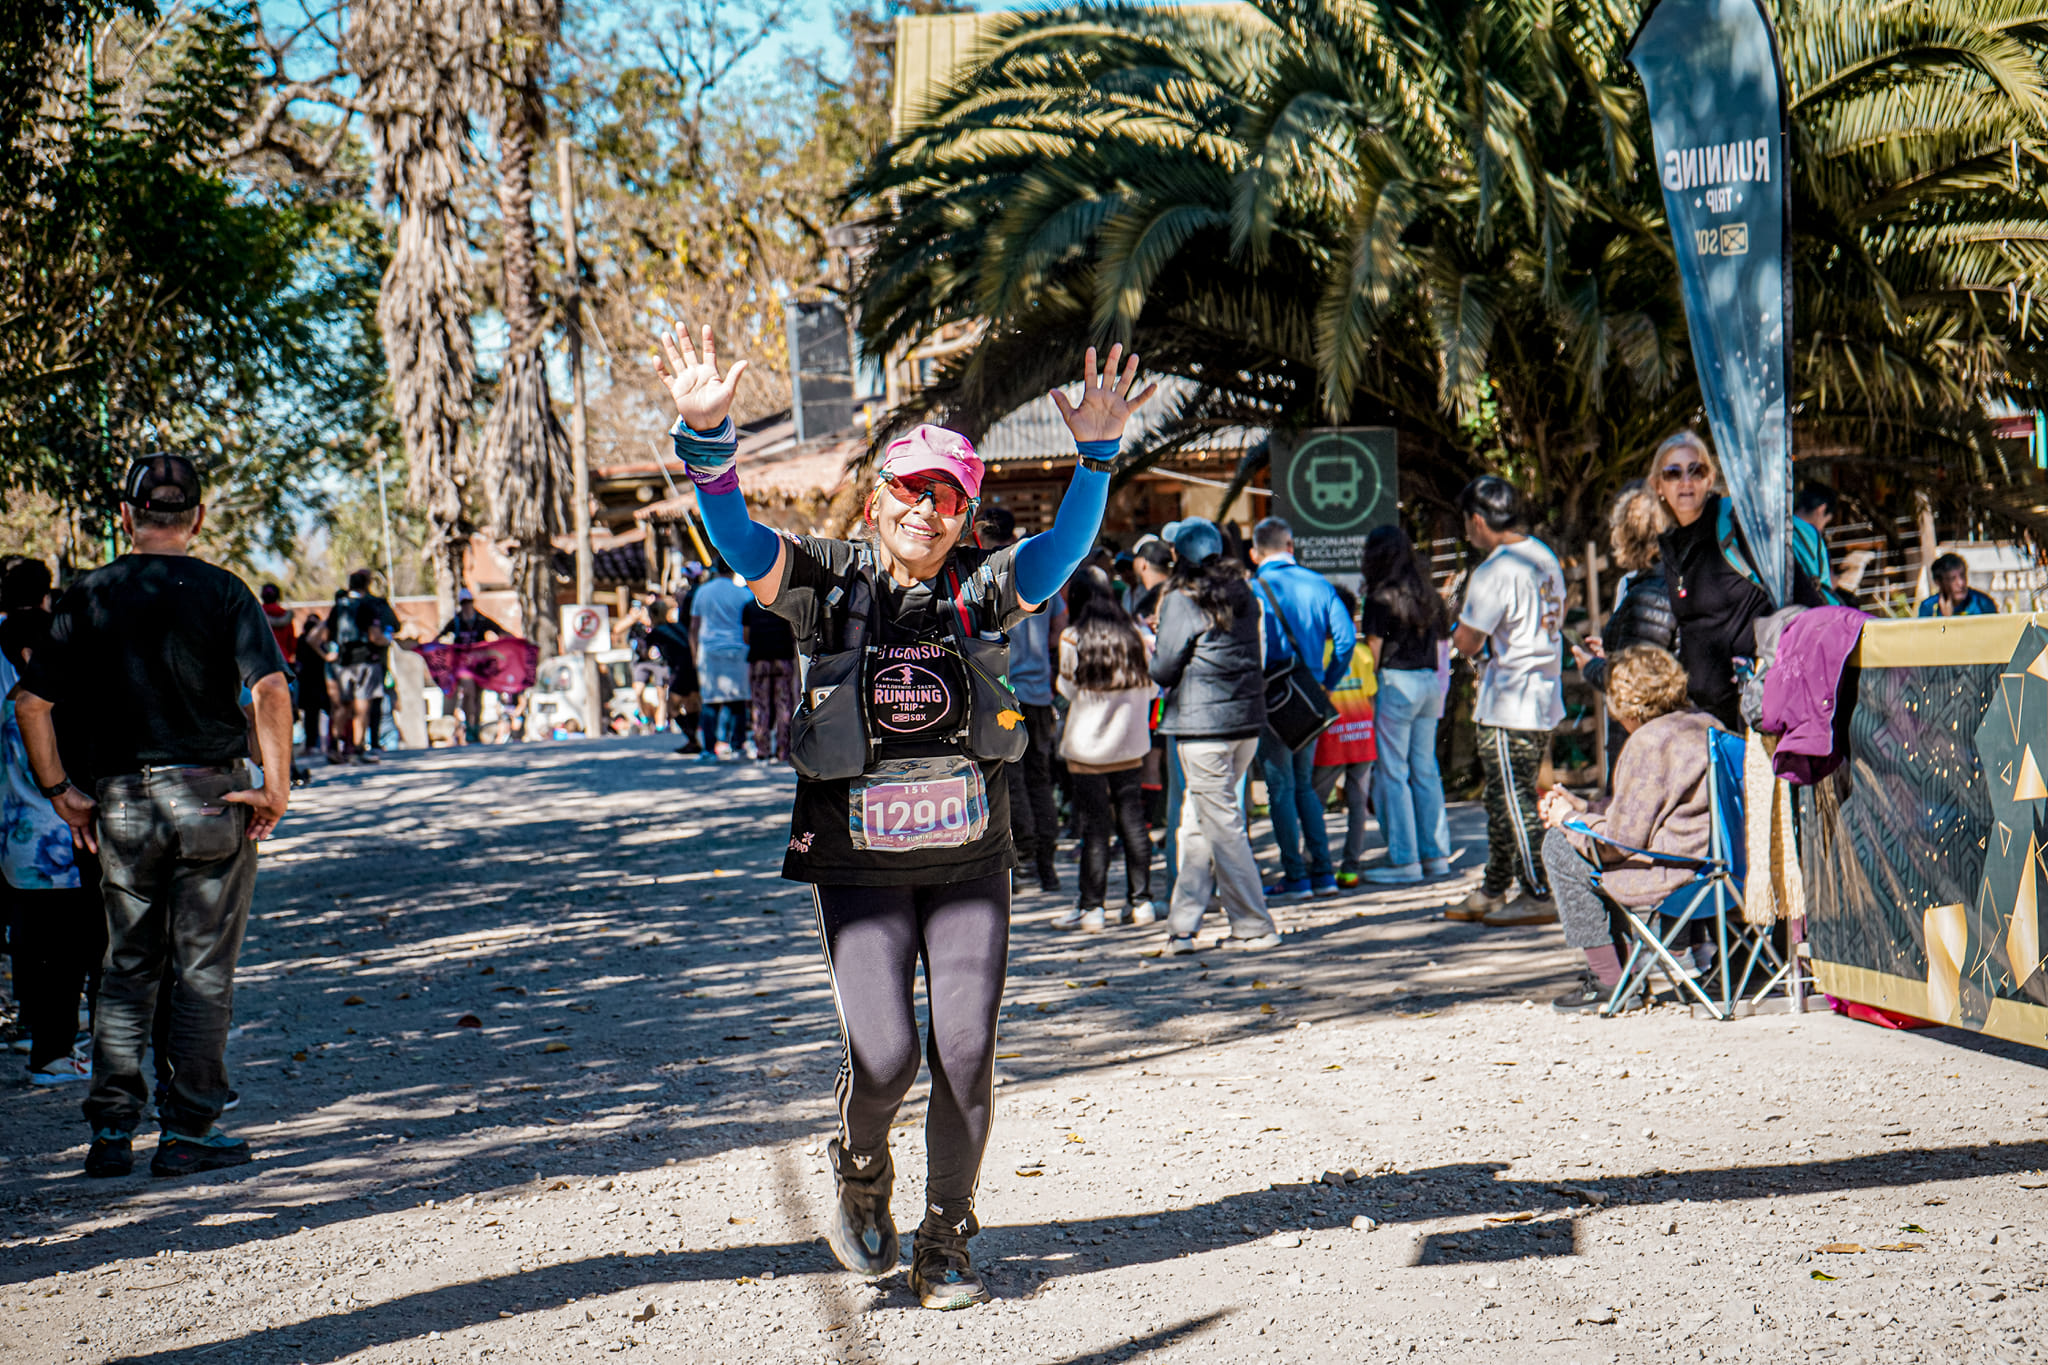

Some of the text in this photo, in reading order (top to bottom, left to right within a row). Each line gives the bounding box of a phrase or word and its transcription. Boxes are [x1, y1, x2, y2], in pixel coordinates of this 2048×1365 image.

[1303, 548, 1365, 559] EXCLUSIV
[874, 689, 942, 704] RUNNING
[899, 703, 919, 712] TRIP
[910, 713, 927, 721] SOX
[868, 796, 965, 836] 1290
